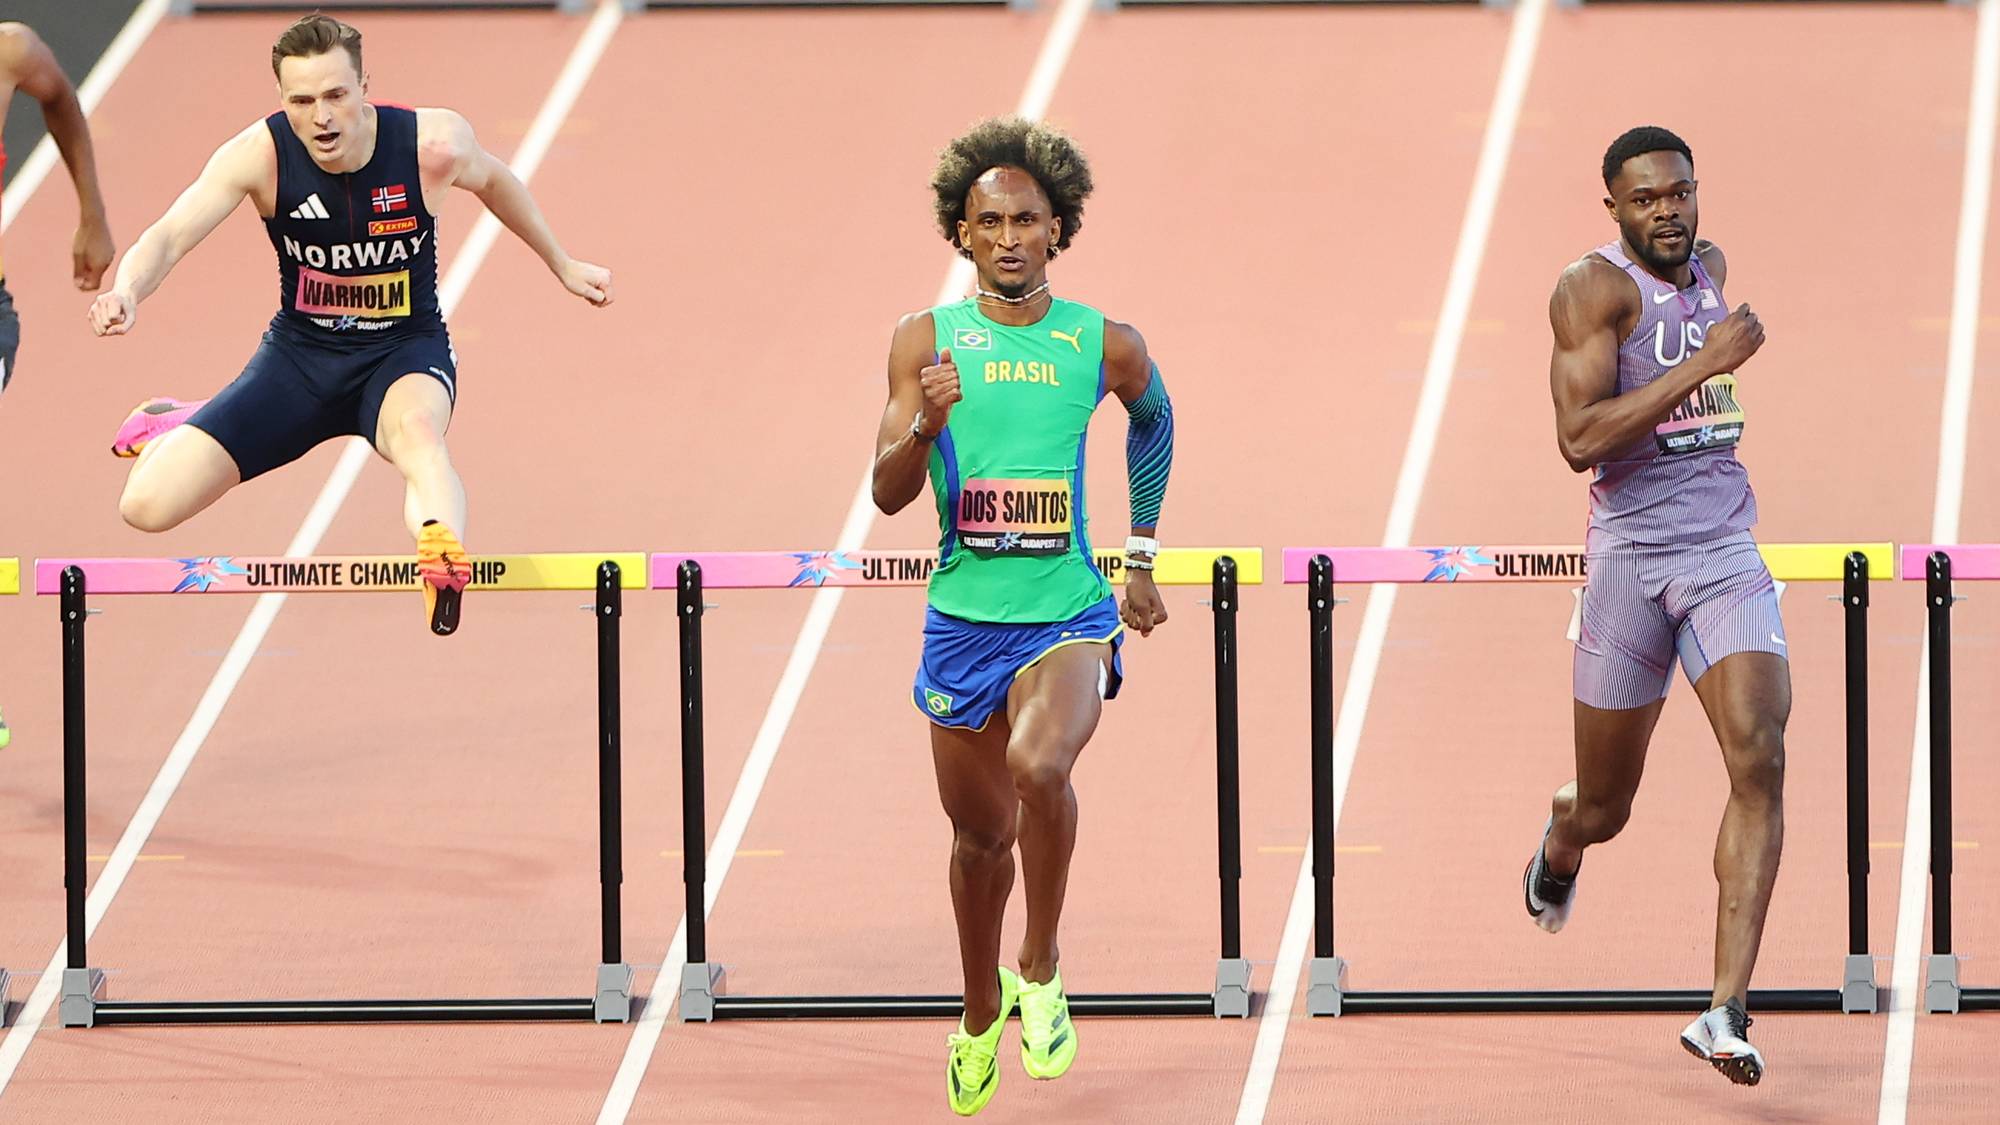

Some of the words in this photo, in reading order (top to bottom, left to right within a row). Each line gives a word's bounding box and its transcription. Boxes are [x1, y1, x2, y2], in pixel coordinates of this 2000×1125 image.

[386, 221, 414, 231] EXTRA
[283, 230, 429, 270] NORWAY
[303, 275, 404, 310] WARHOLM
[1654, 319, 1717, 367] US
[984, 360, 1060, 386] BRASIL
[1666, 434, 1697, 448] ULTIMATE
[962, 489, 997, 523] DOS
[1003, 490, 1068, 524] SANTOS
[964, 536, 996, 548] ULTIMATE
[1020, 538, 1056, 549] BUDAPEST
[246, 563, 343, 586] ULTIMATE
[350, 561, 506, 586] CHAMPHIP
[862, 557, 938, 581] ULTIMA
